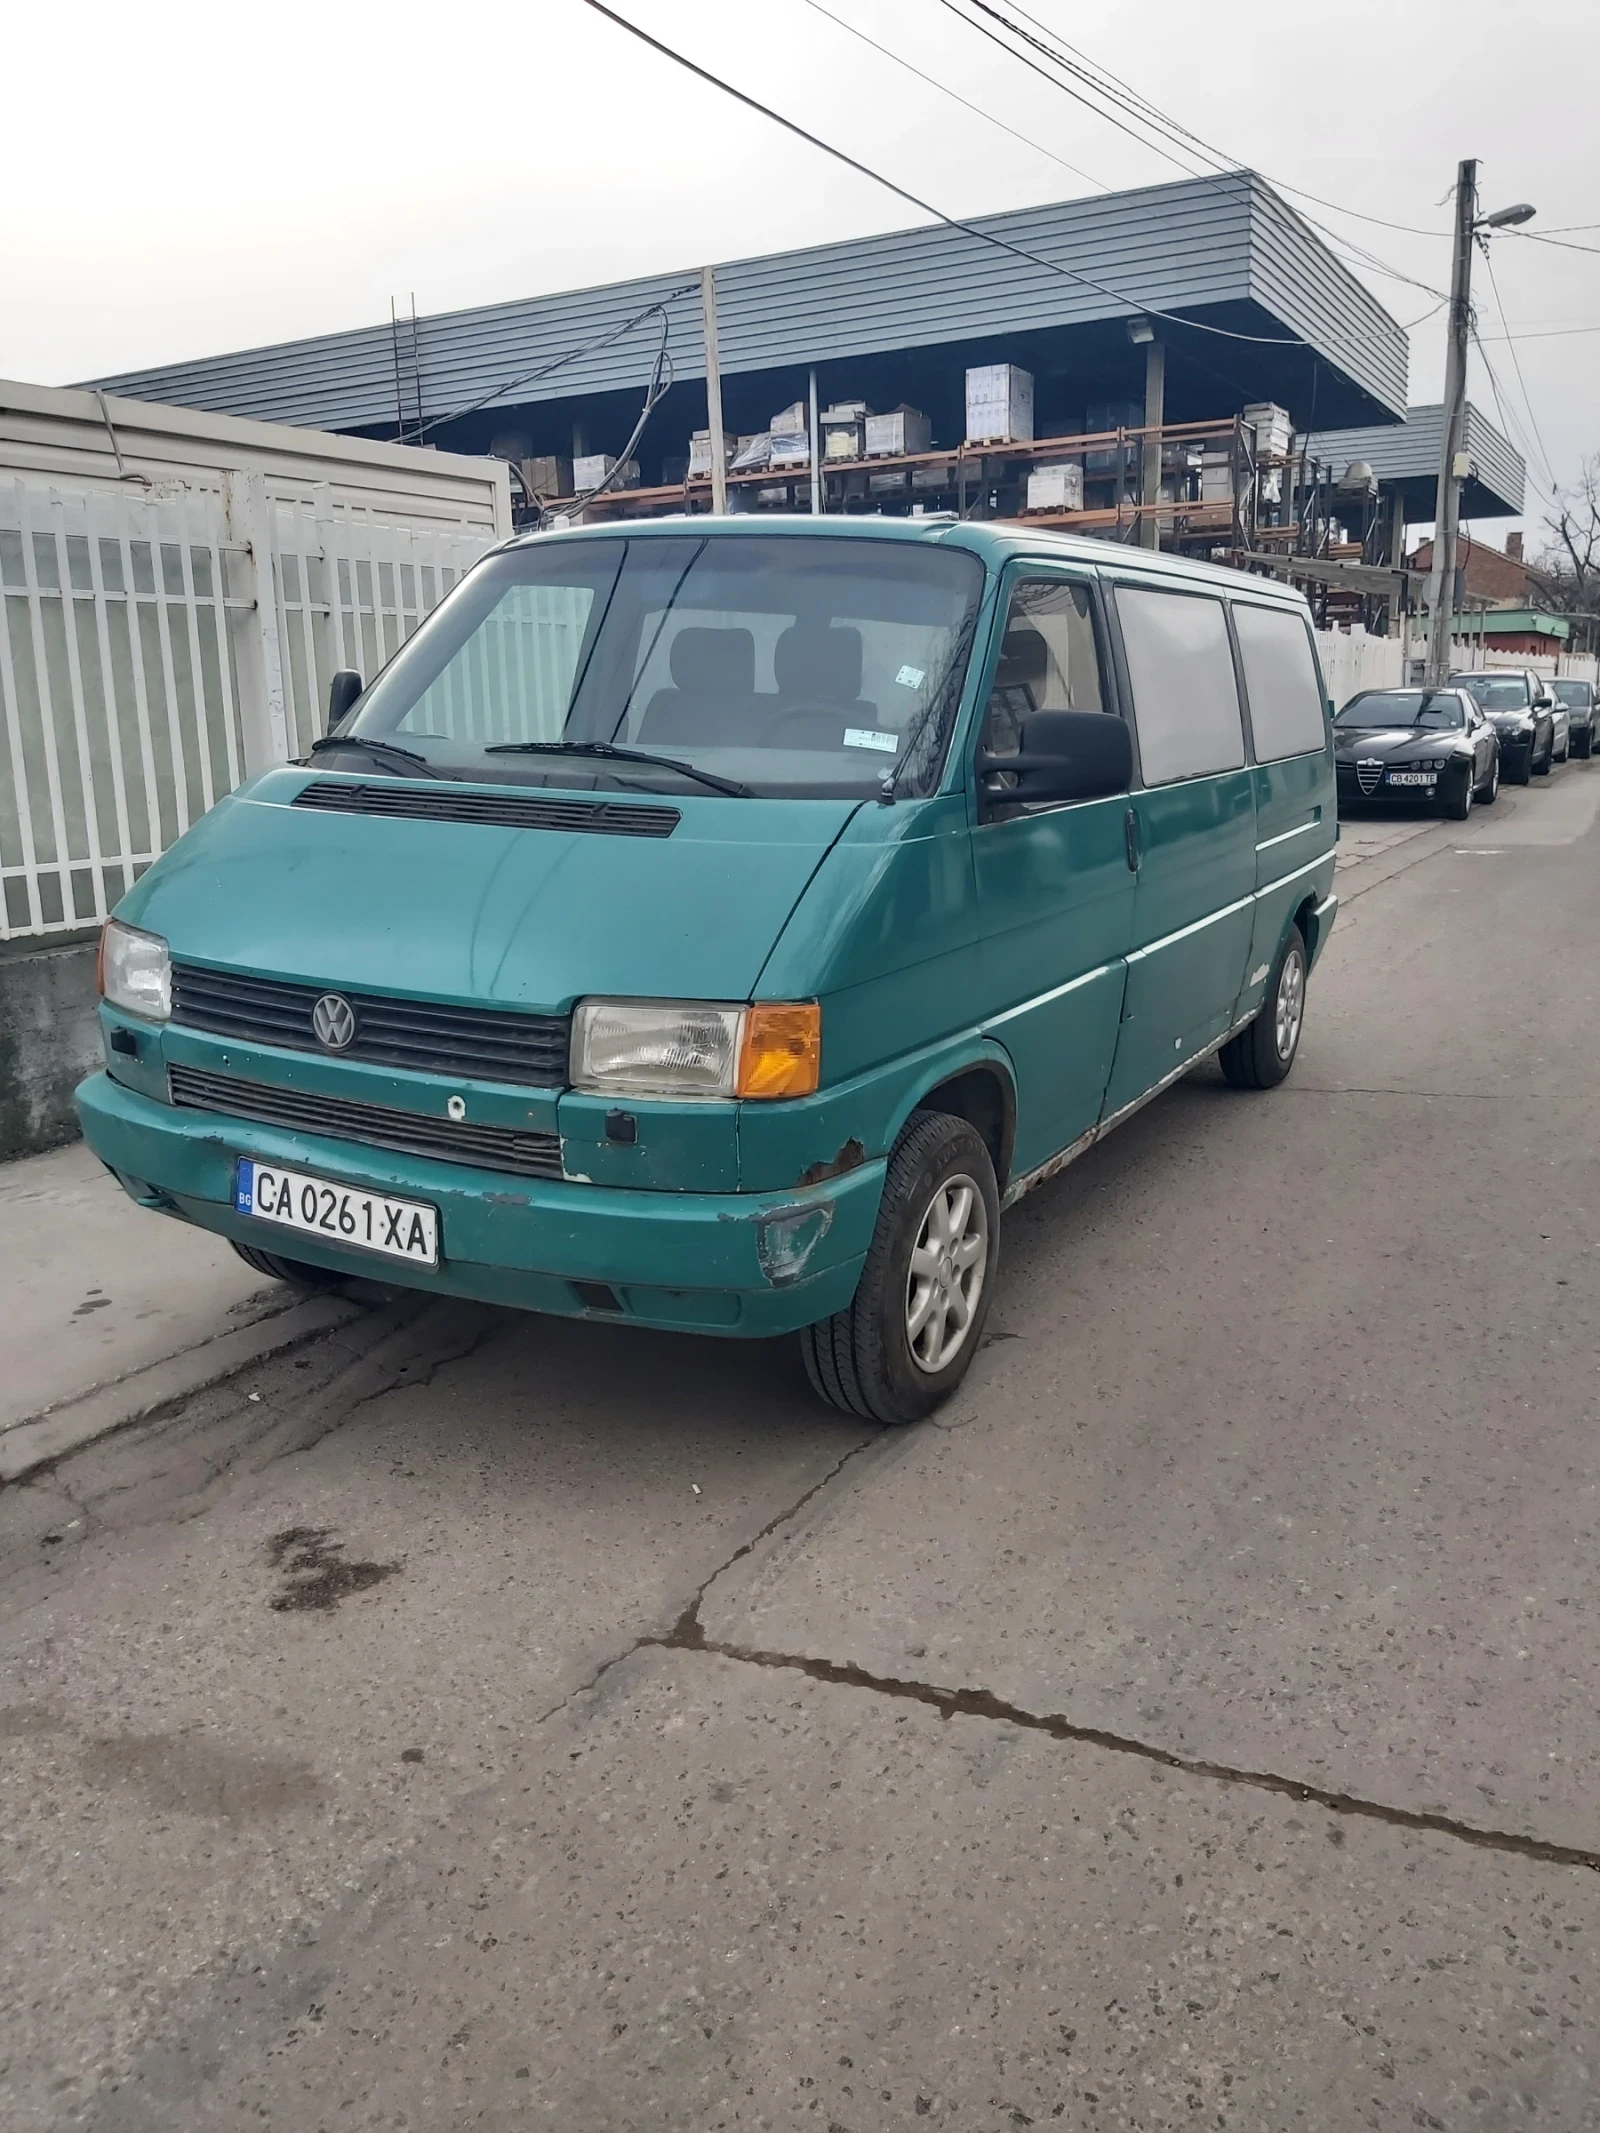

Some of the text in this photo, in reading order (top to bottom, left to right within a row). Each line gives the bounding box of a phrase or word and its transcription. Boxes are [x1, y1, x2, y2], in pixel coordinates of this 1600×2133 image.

[1391, 774, 1435, 783] CB 4201 TE
[314, 996, 355, 1047] VW
[239, 1192, 252, 1206] BG
[257, 1171, 428, 1255] CA 0261 XA
